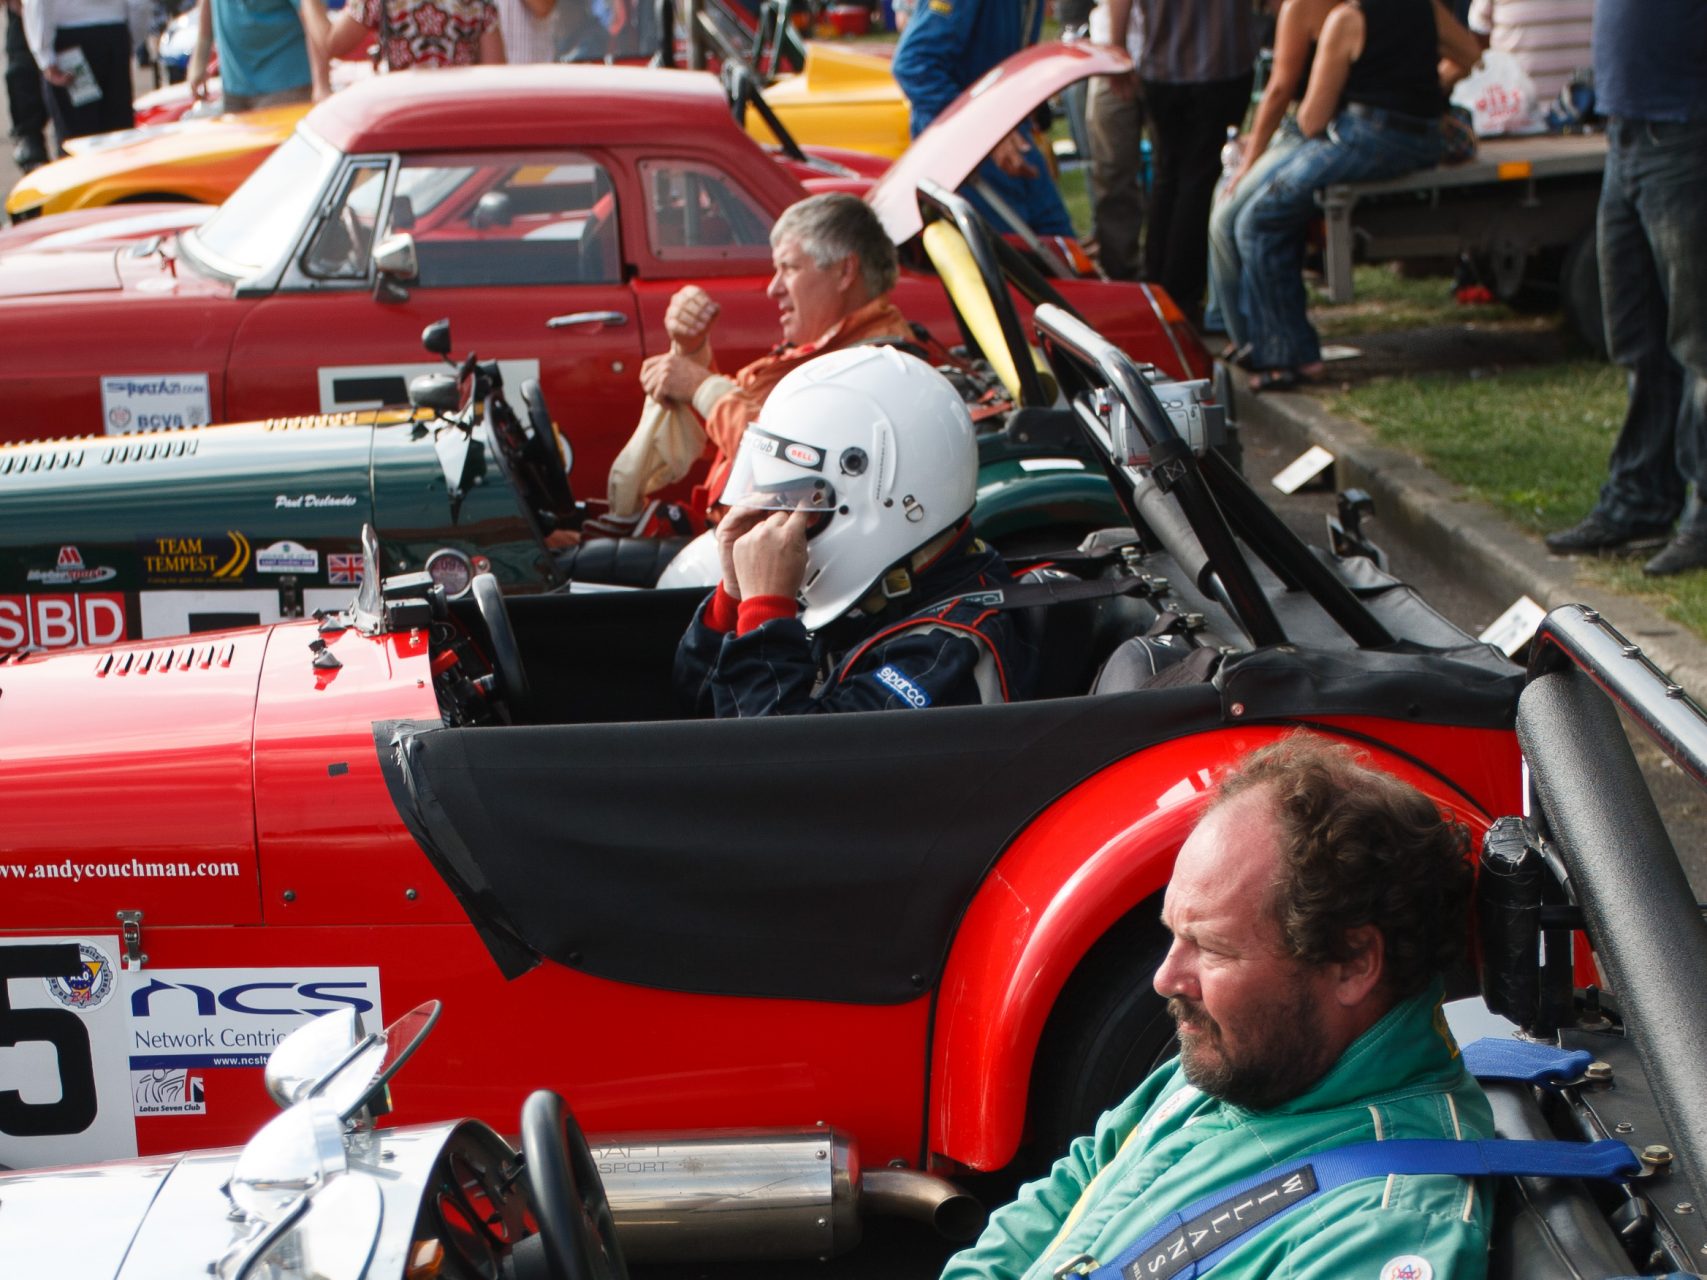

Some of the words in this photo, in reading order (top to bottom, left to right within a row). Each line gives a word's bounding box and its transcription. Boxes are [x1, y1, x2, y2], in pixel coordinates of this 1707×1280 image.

[275, 494, 303, 509] Paul
[156, 538, 203, 554] TEAM
[144, 555, 218, 572] TEMPEST
[879, 666, 927, 707] sparco
[131, 978, 373, 1018] ncs
[135, 1027, 214, 1048] Network
[213, 1055, 269, 1065] www.ncslt
[183, 1103, 201, 1111] Club
[1148, 1173, 1305, 1274] WILLANS
